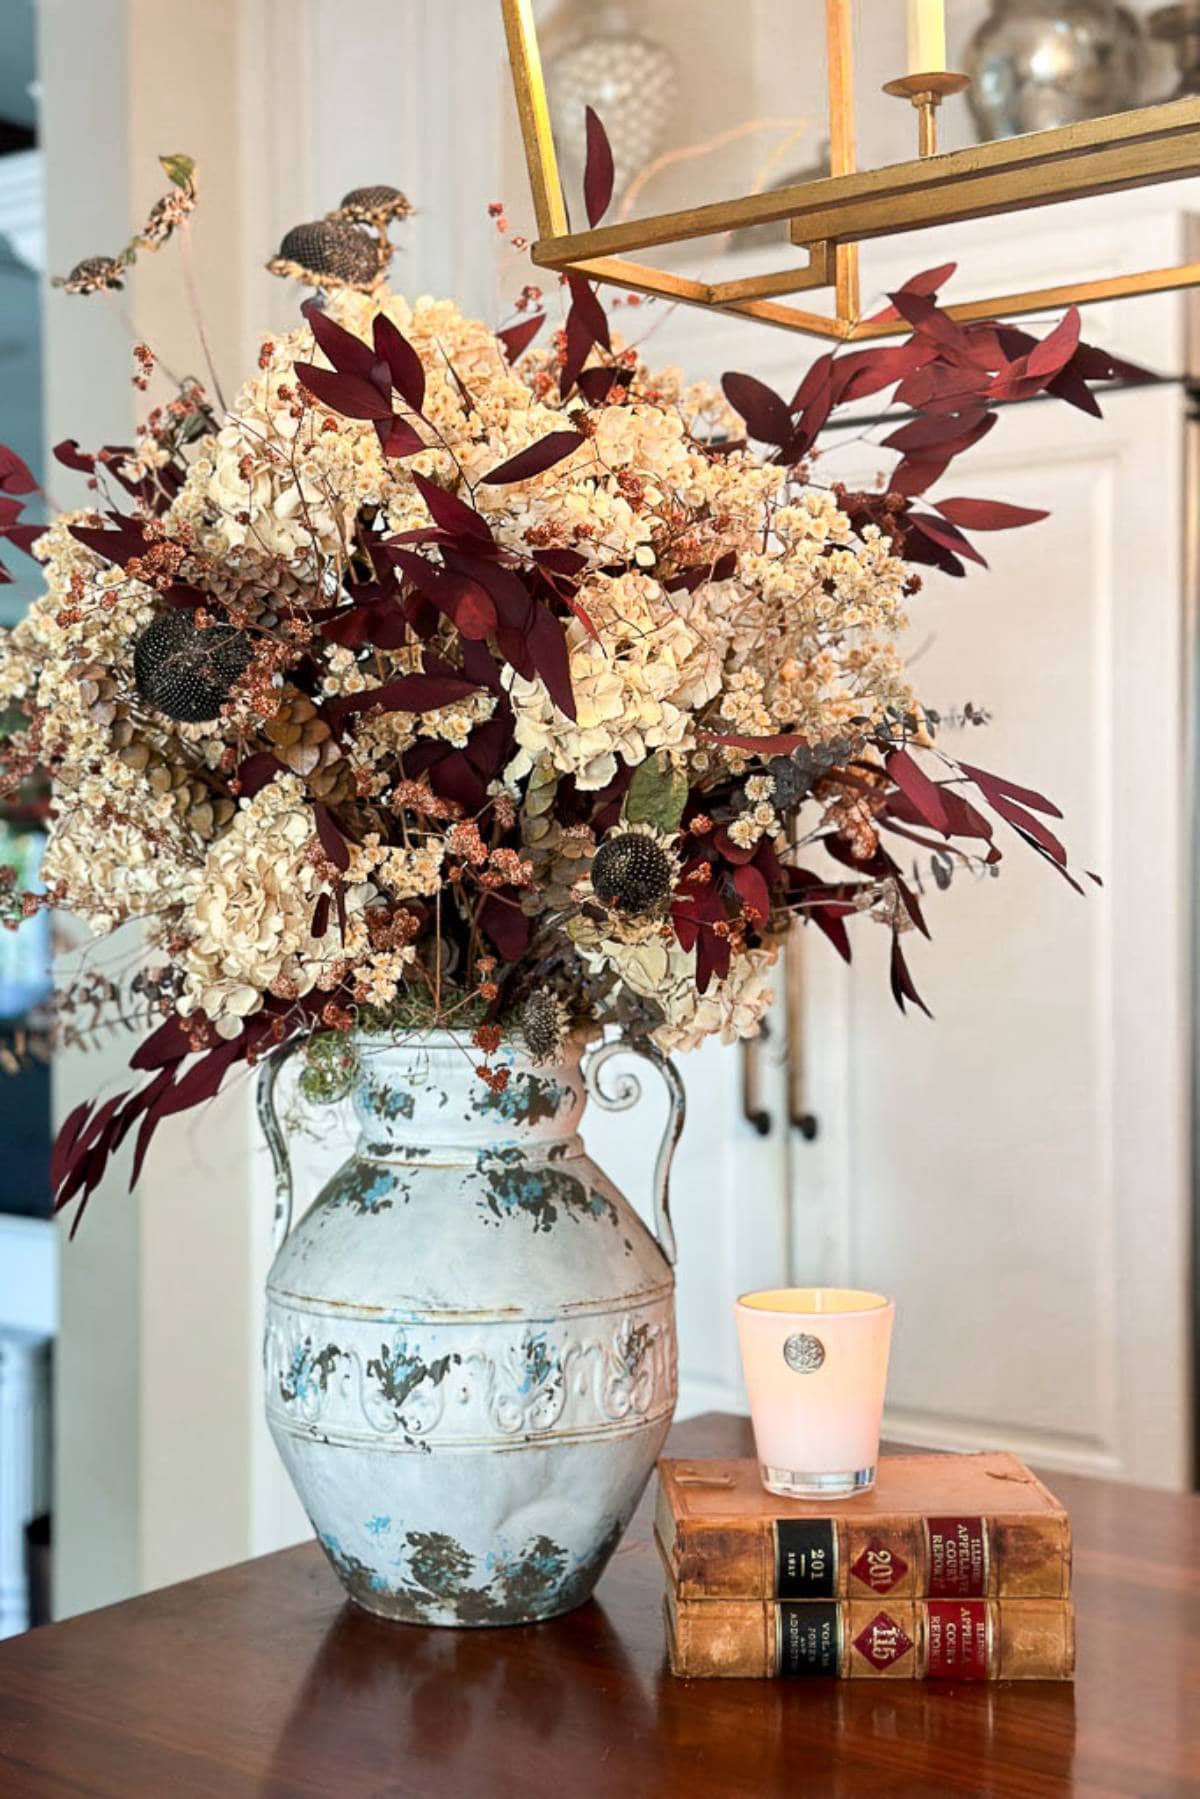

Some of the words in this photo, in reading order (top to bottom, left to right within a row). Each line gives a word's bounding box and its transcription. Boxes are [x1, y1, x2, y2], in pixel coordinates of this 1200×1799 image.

[811, 1549, 825, 1580] 201
[867, 1550, 894, 1587] 201
[872, 1626, 898, 1659] 115
